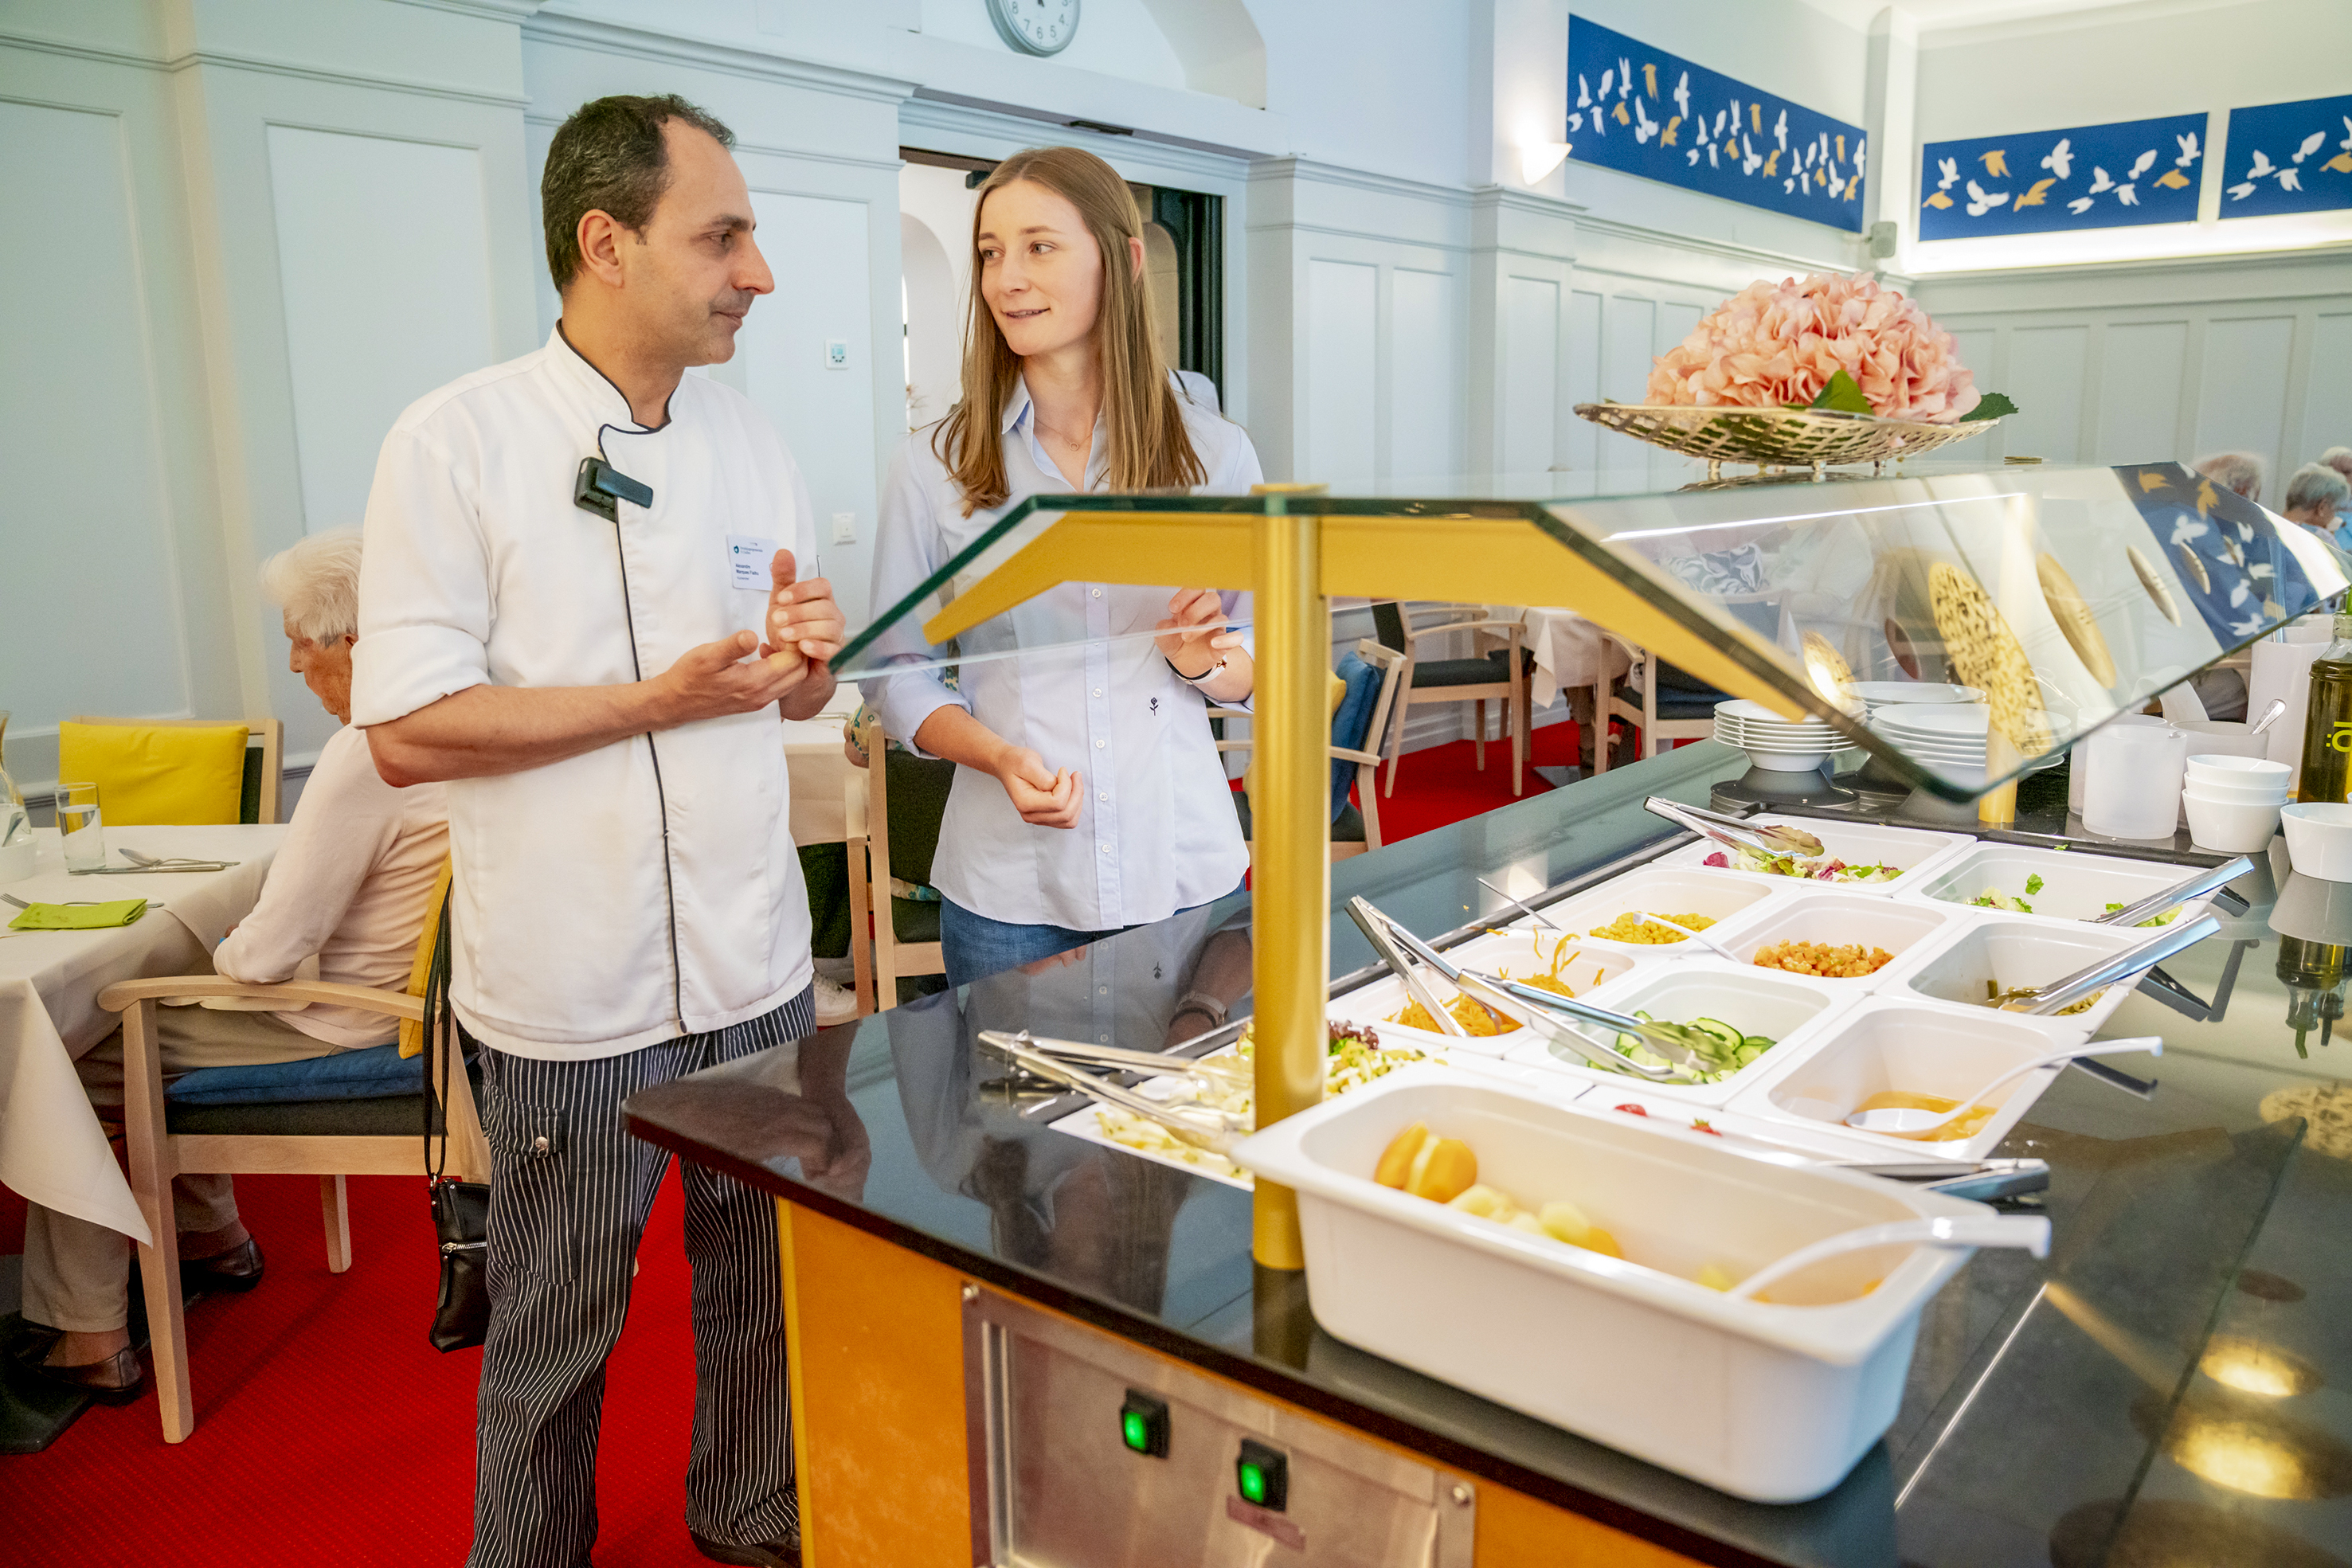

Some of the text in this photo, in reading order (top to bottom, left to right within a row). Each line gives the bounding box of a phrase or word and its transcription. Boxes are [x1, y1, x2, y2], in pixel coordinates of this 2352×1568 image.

[1012, 2, 1019, 14] 8
[1023, 18, 1031, 31] 7
[1059, 14, 1065, 25] 4
[1036, 26, 1043, 40] 6
[1050, 25, 1057, 38] 5
